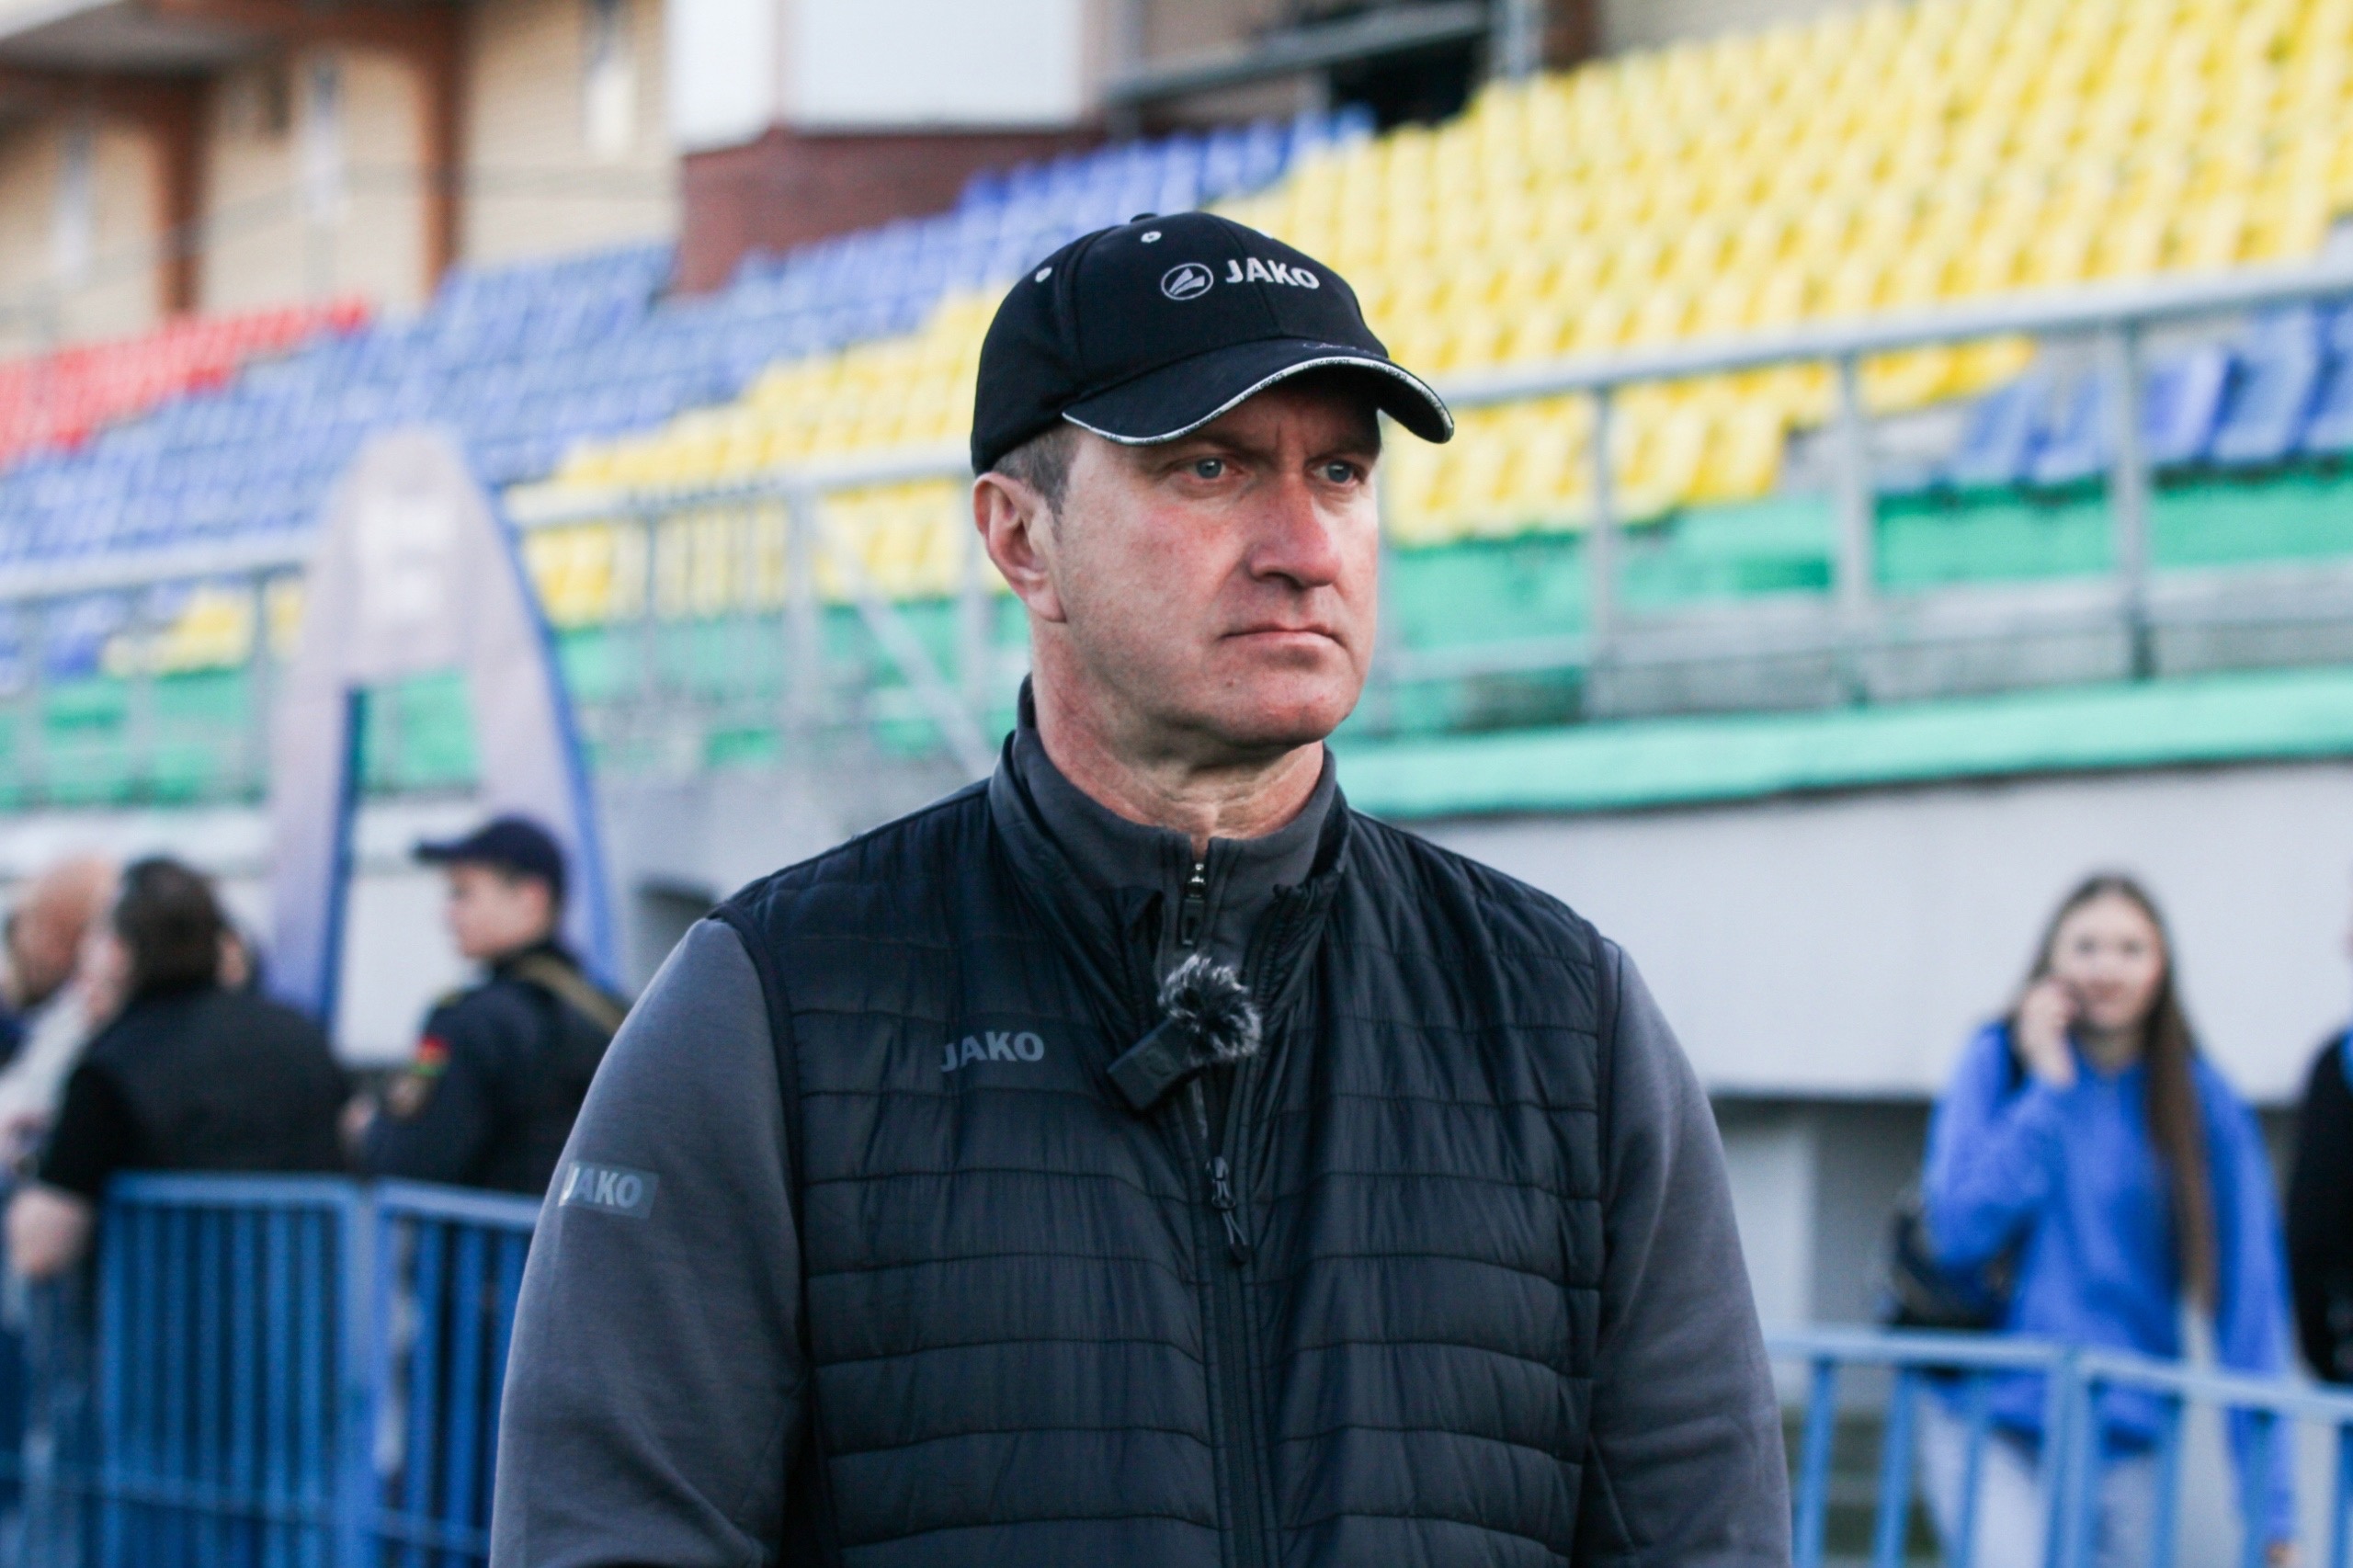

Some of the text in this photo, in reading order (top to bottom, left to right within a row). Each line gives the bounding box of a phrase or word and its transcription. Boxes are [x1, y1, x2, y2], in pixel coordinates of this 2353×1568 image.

[1225, 256, 1320, 290] JAKO
[939, 1031, 1045, 1073] JAKO
[559, 1166, 642, 1209] JAKO
